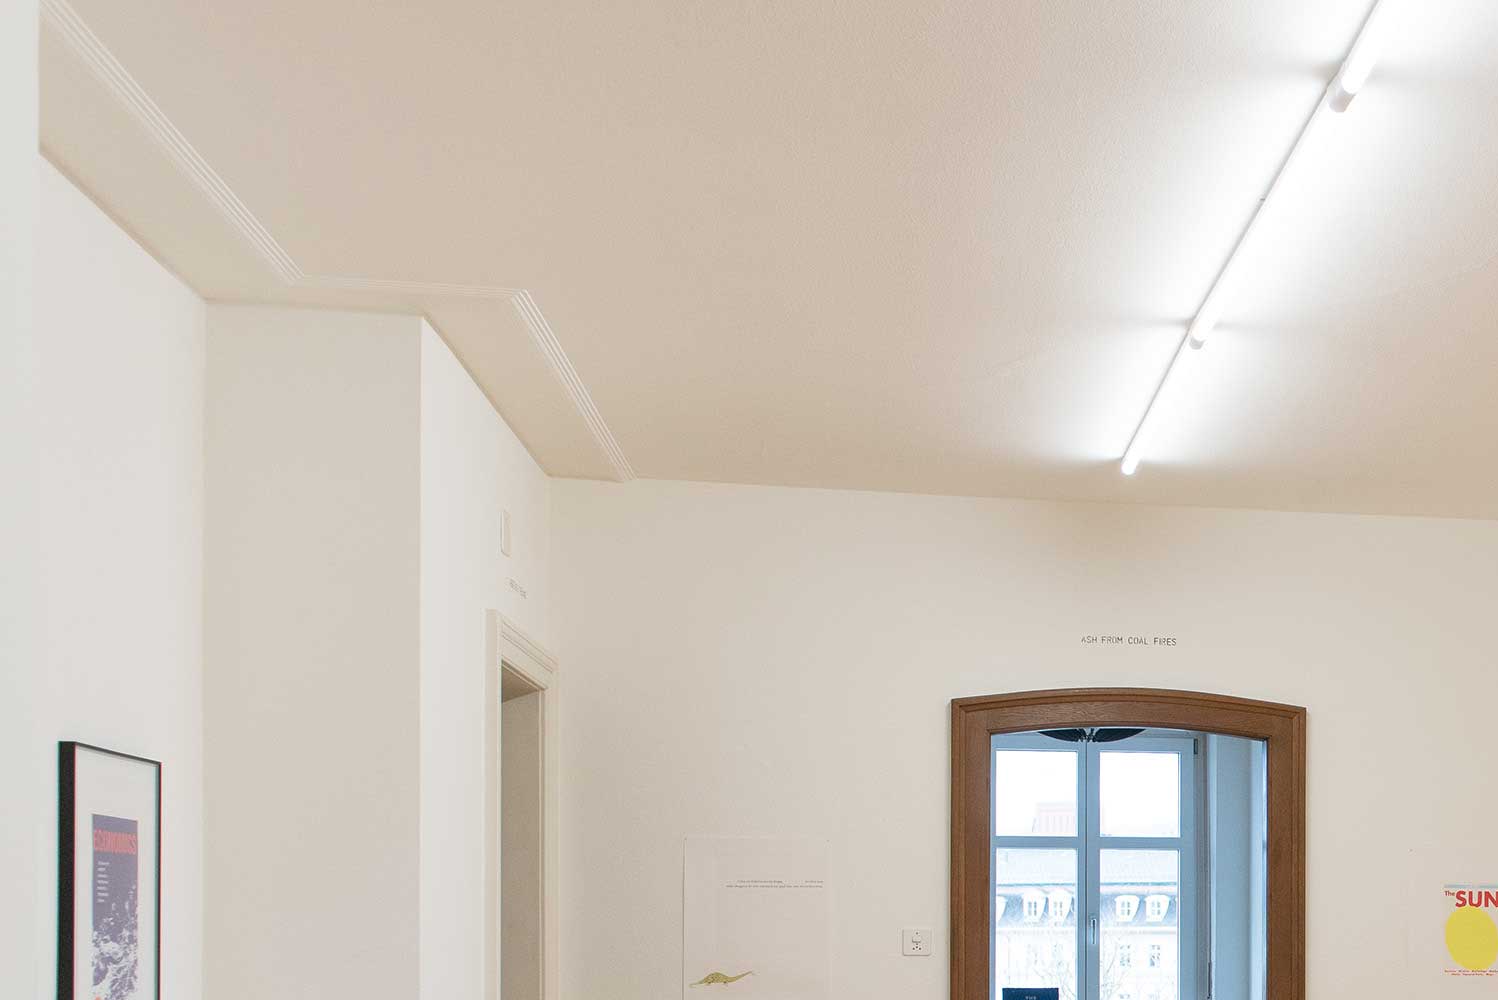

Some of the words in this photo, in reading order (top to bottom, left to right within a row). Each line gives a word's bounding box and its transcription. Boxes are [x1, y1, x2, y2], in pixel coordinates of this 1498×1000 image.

[1081, 635, 1098, 644] ASH
[1101, 635, 1124, 645] FROM
[1127, 636, 1149, 645] COAL
[1153, 637, 1177, 647] FIRES
